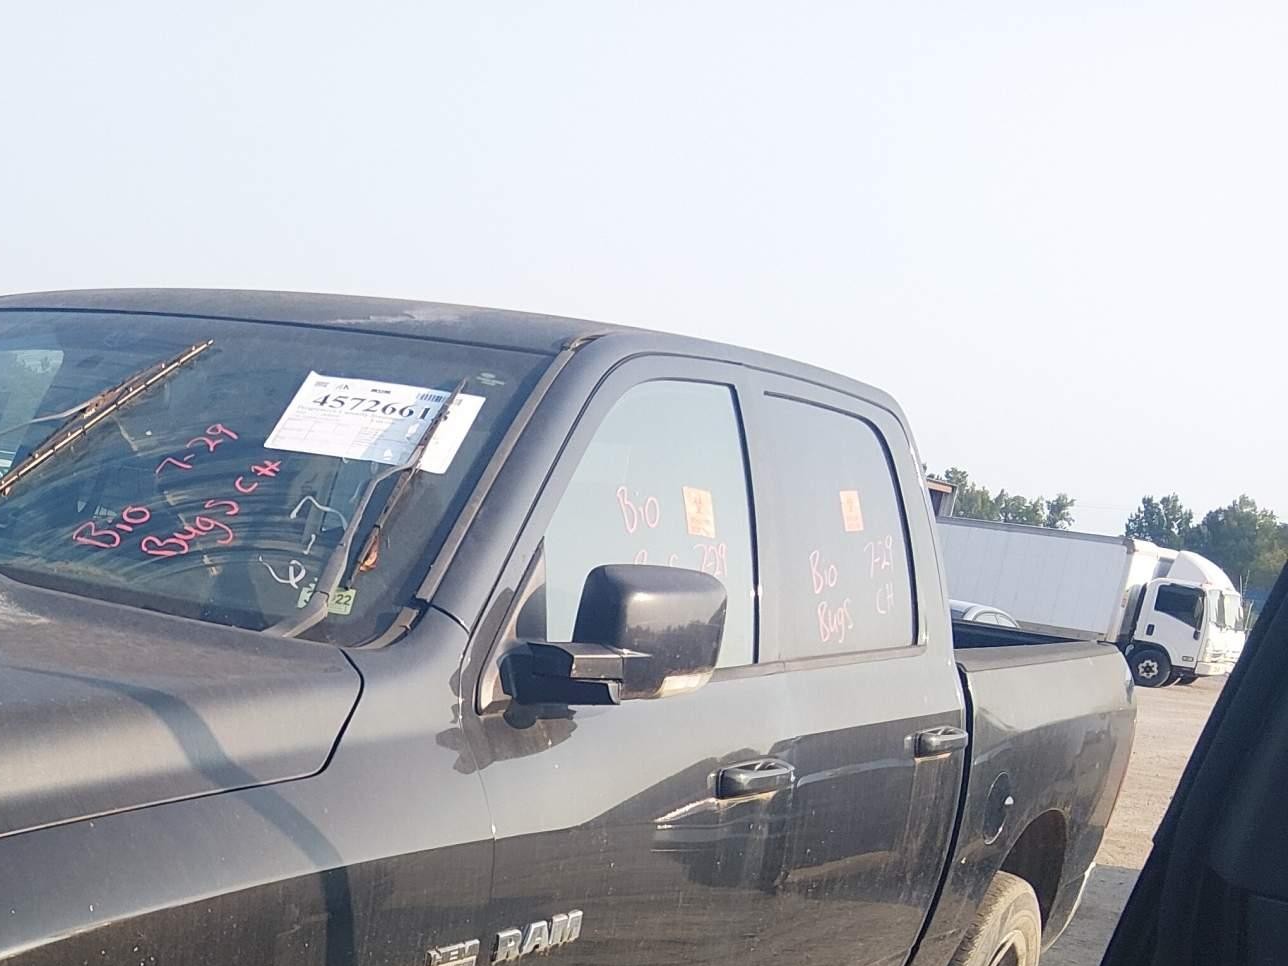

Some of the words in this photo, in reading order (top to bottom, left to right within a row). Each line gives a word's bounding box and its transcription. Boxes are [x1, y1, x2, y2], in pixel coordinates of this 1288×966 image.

[155, 423, 239, 476] 7-29
[141, 499, 240, 556] Bugs
[492, 909, 584, 966] RAM
